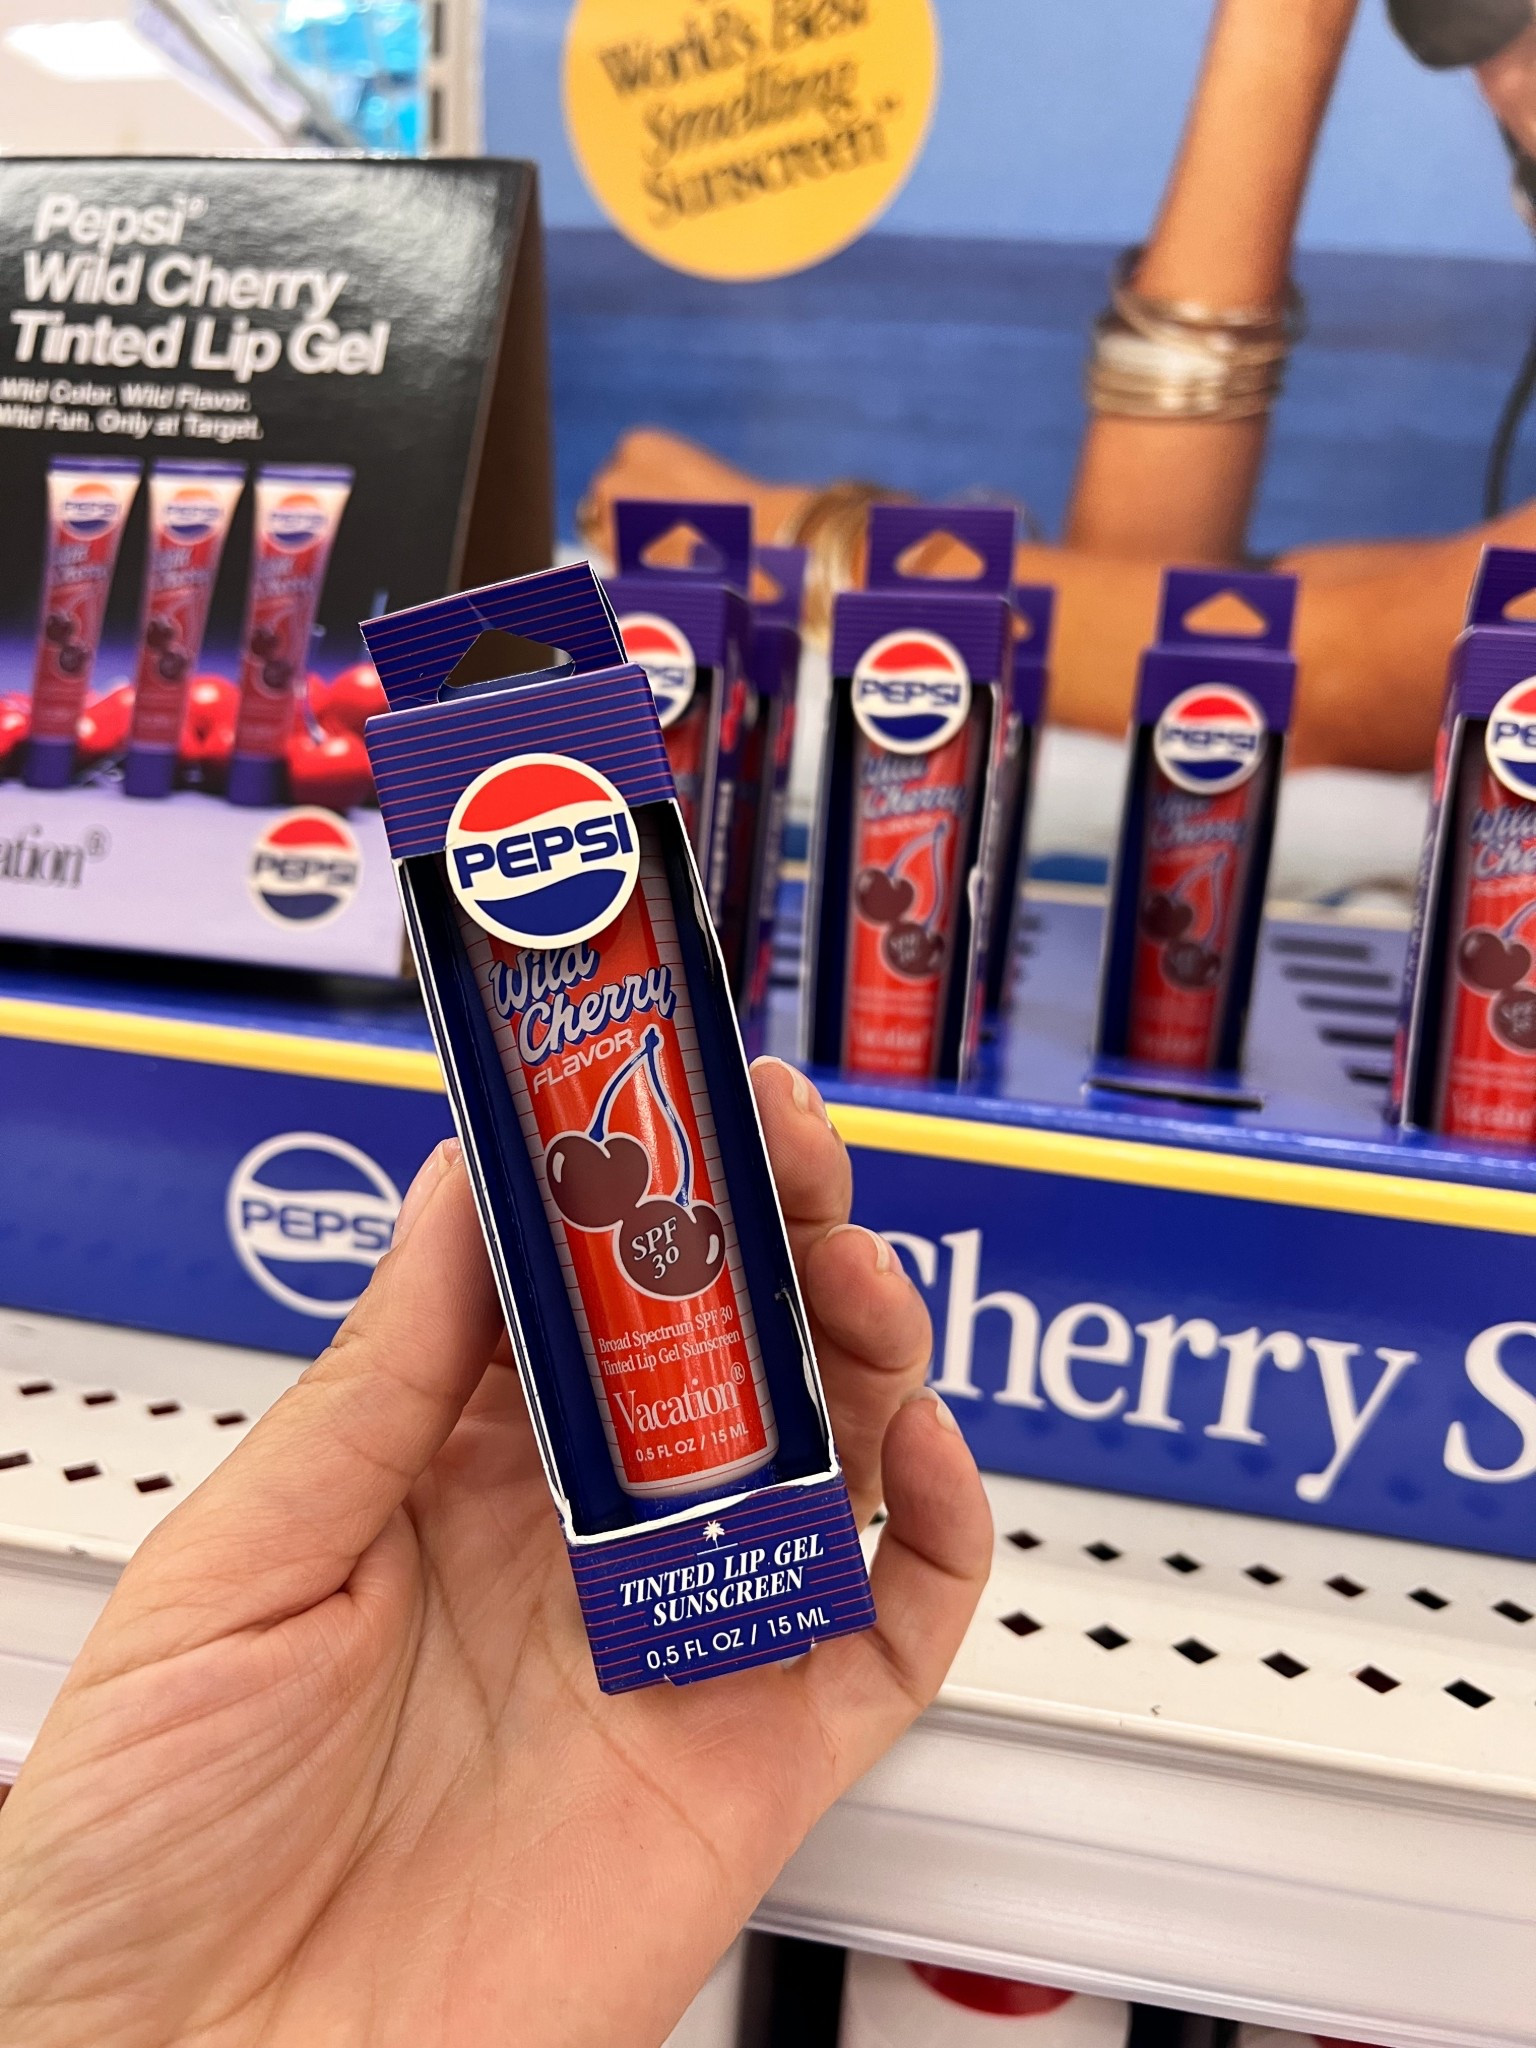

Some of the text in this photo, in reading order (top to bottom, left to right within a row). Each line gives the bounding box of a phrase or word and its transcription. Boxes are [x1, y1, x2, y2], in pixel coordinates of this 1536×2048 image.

[24, 251, 349, 322] Wild Cherry
[11, 309, 392, 383] Tinted Lip Gel
[120, 382, 175, 409] Wild
[95, 408, 153, 439] Only
[153, 412, 180, 436] at
[859, 679, 961, 706] PEPSI
[253, 852, 358, 886] PEPSI
[452, 812, 634, 889] PEPSI
[489, 942, 600, 1019] Wild
[518, 966, 677, 1066] Cherry
[631, 1216, 677, 1261] SPF
[652, 1246, 680, 1279] 30
[598, 1305, 733, 1354] Broad Spectrum SPF 30
[601, 1330, 741, 1376] Tinted Lip Gel Sunscreen
[635, 1421, 749, 1463] 0.5 FL OZ / 15 ML
[619, 1533, 824, 1607] TINTED LIP GEL
[653, 1566, 804, 1627] SUNSCREEN
[646, 1607, 830, 1670] 0.5 FL OZ / 15 ML
